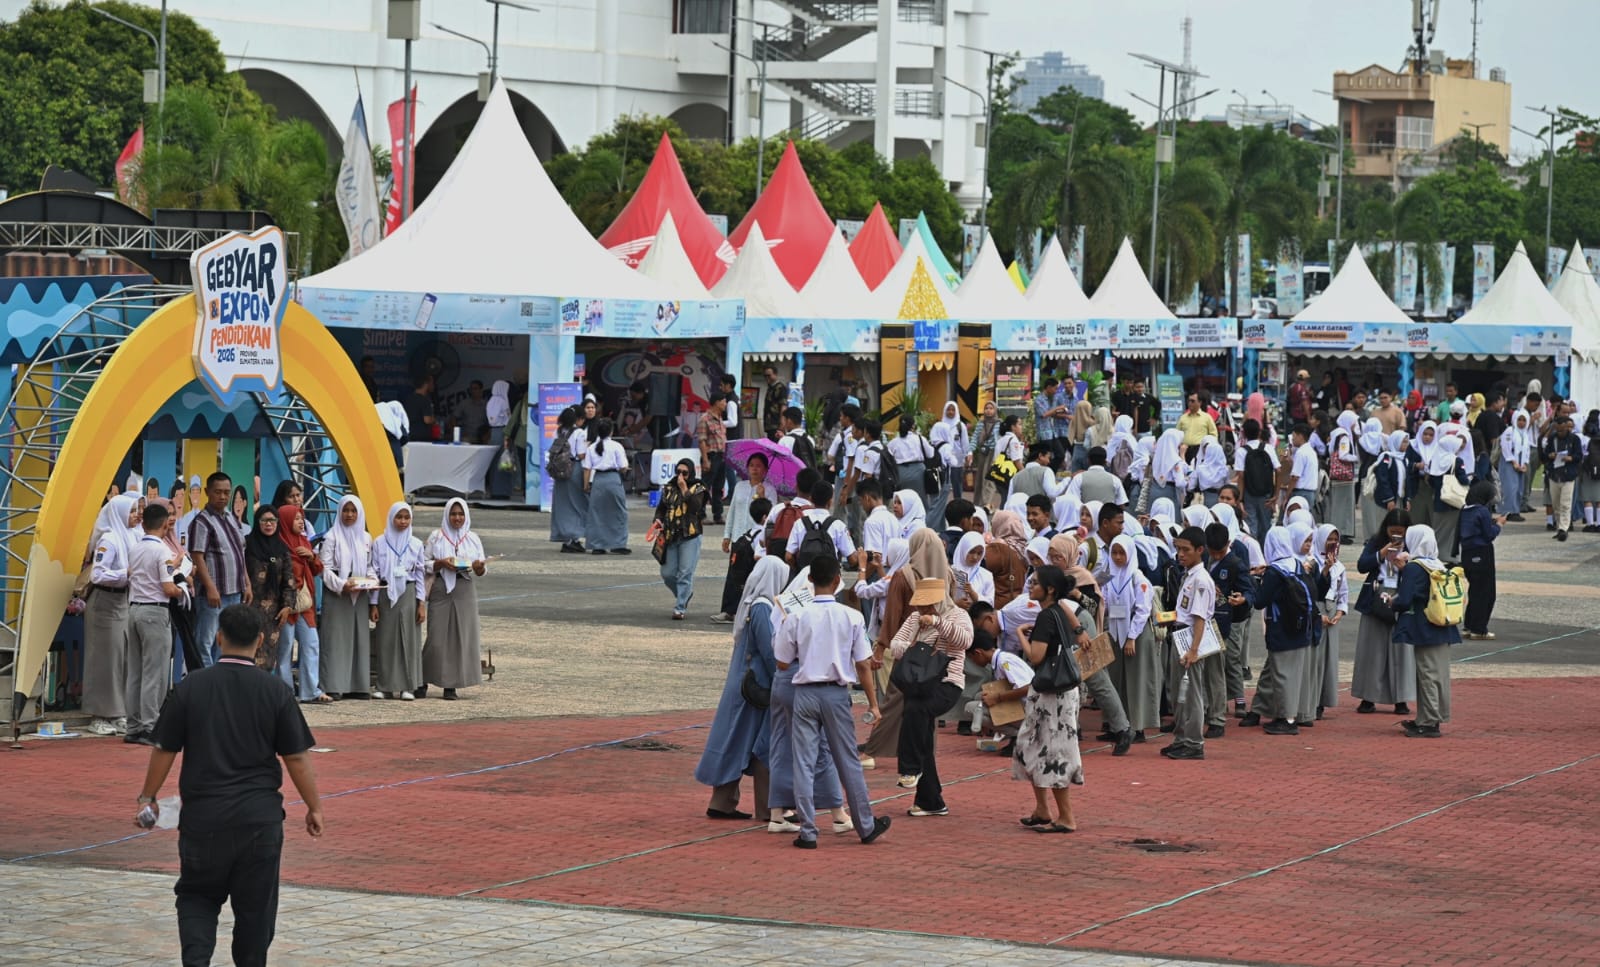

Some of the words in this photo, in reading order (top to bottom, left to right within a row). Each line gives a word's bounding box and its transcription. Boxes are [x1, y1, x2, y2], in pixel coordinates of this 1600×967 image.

[206, 242, 277, 306] GEBYAR
[210, 300, 219, 319] &
[220, 291, 260, 324] EXPO
[1076, 323, 1086, 335] EV
[1128, 324, 1150, 337] SHEP
[217, 347, 235, 362] 2026
